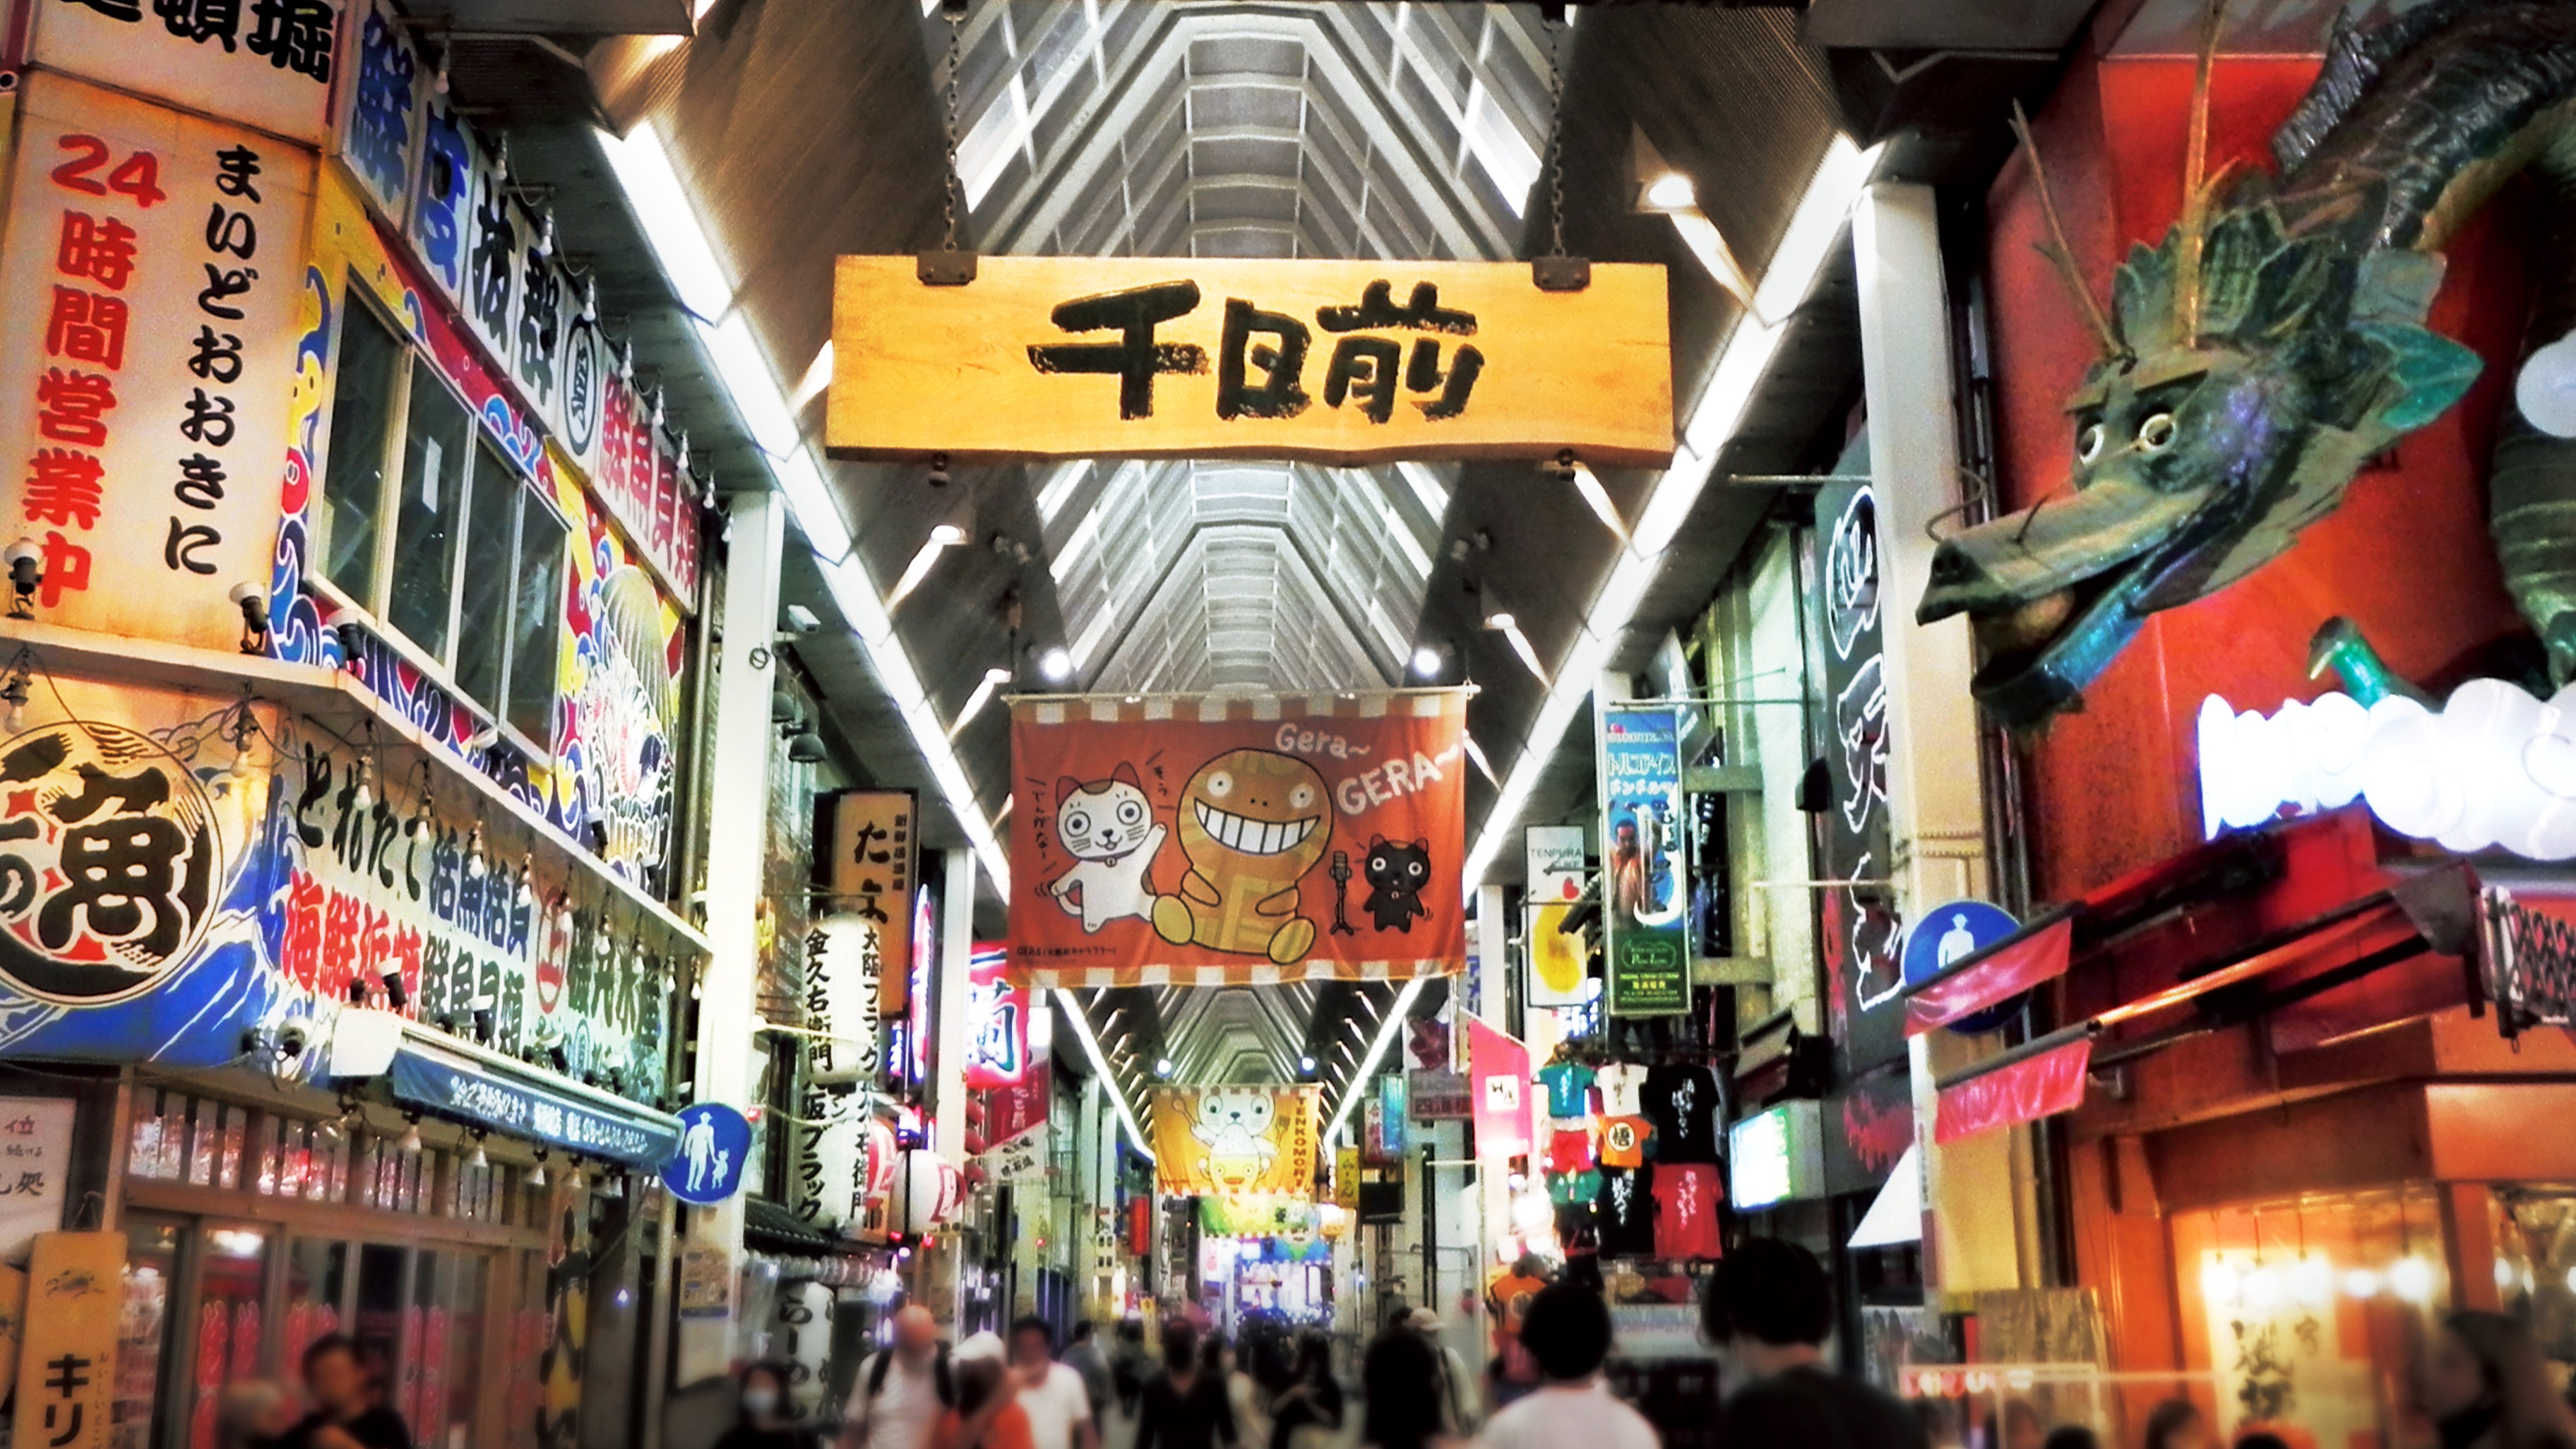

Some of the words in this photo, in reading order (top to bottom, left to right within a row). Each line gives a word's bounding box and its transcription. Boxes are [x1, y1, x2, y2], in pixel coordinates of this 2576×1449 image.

[59, 0, 334, 83] 頓堀
[164, 145, 261, 574] まいどおおきに
[1027, 279, 1484, 422] 千日前
[805, 926, 833, 1073] 金久右衛門
